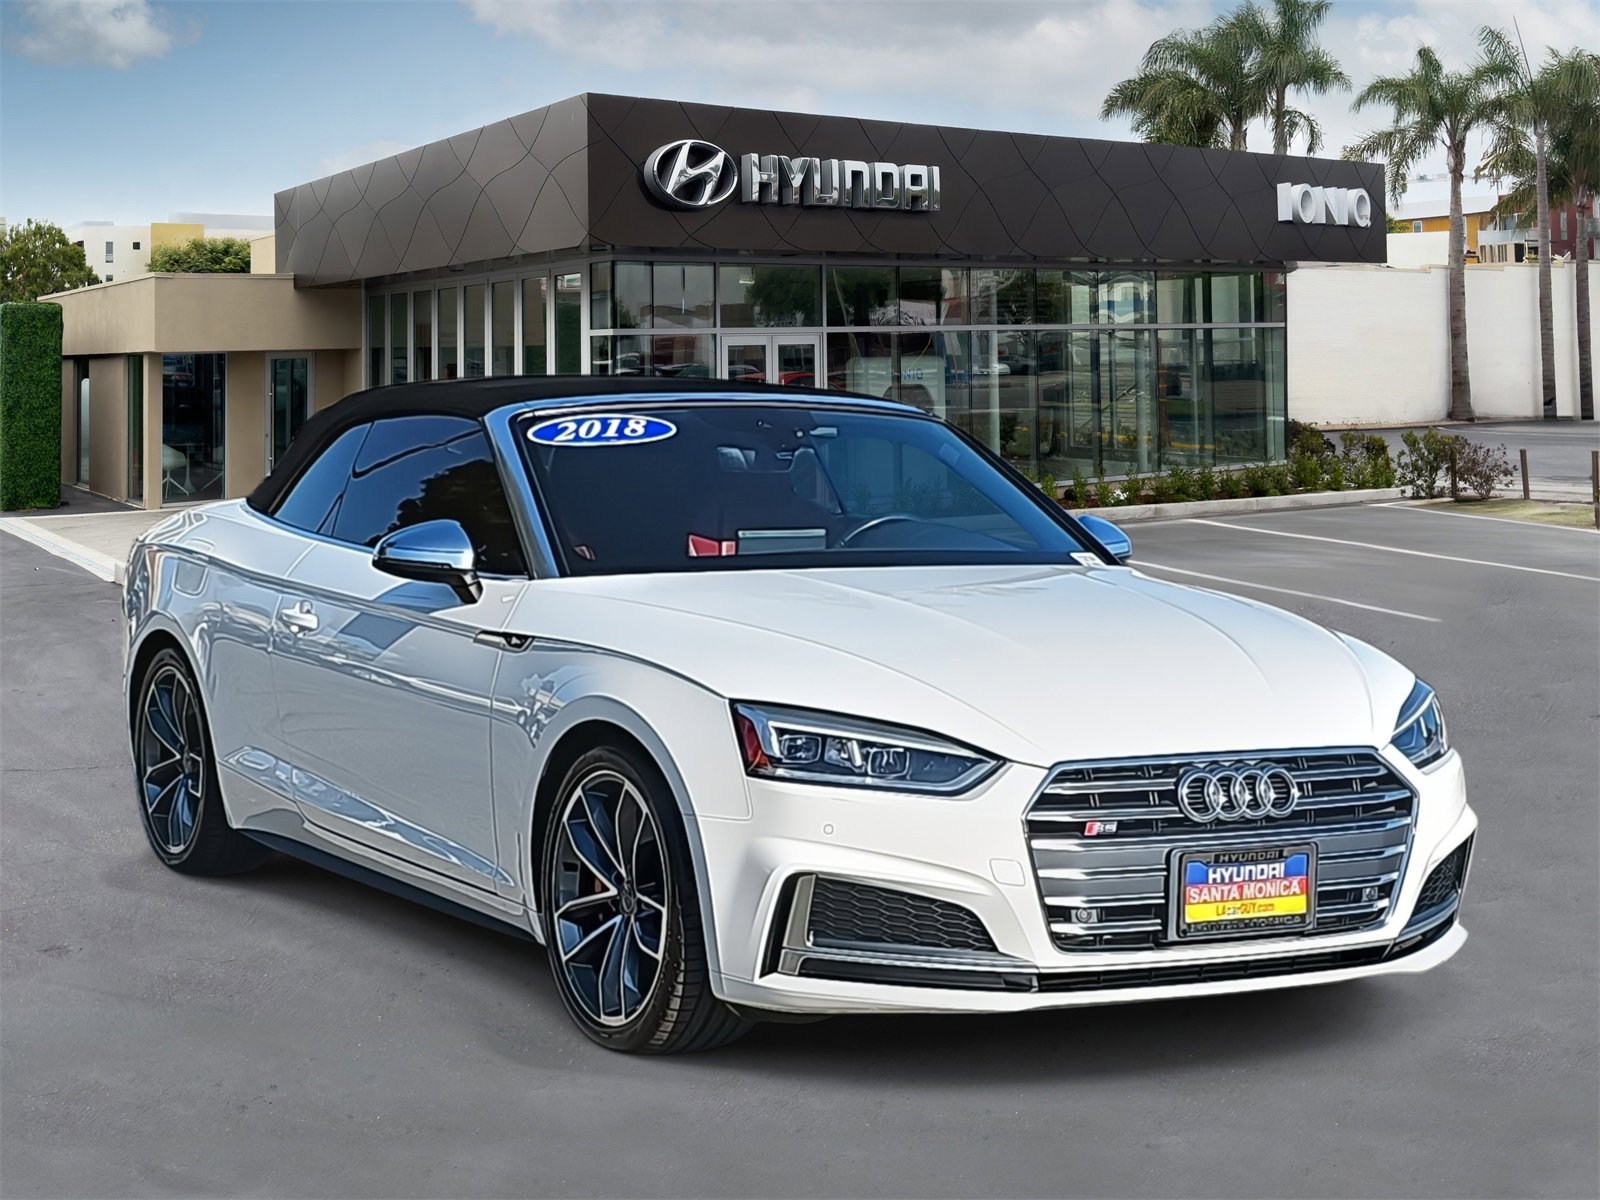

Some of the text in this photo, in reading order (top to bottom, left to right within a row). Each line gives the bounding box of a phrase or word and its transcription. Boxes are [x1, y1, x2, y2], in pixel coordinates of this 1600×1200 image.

[741, 153, 941, 211] HYUNDAI
[1277, 182, 1371, 228] IONIQ
[553, 418, 647, 441] 2018
[1219, 850, 1279, 863] HYUNDAI
[1208, 862, 1286, 884] HYUNDAI
[1190, 879, 1301, 904] SANTA MONICA
